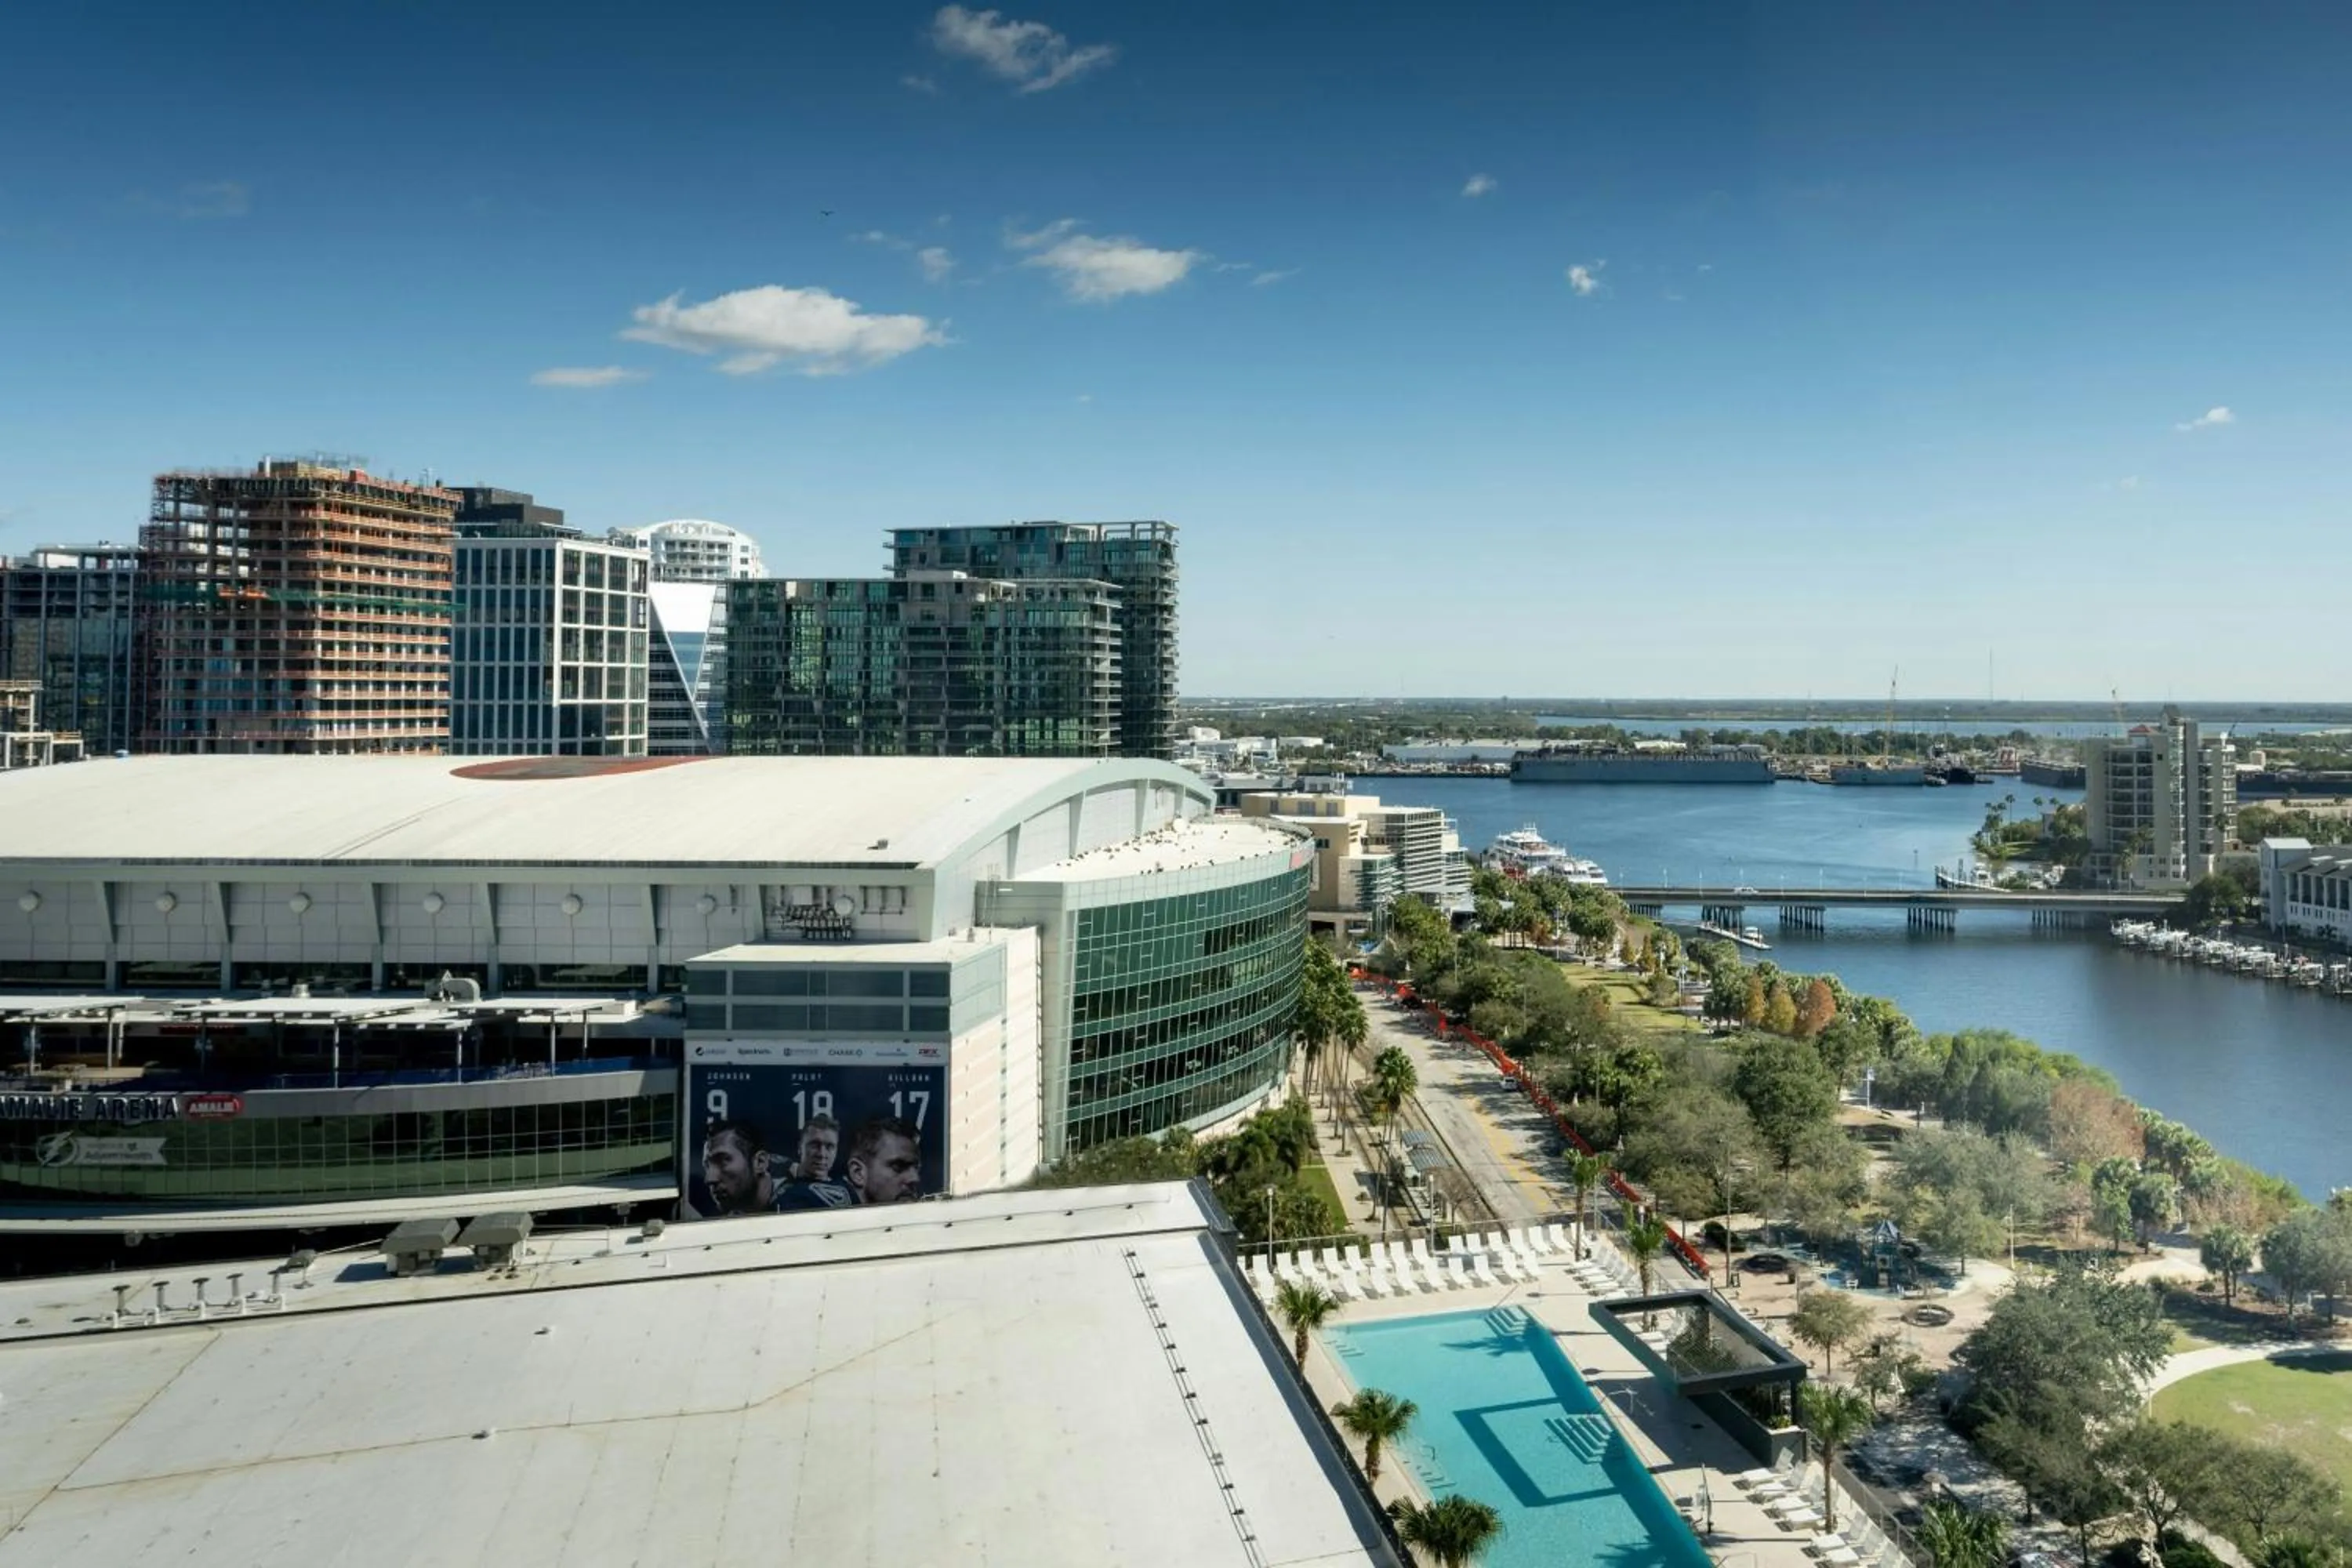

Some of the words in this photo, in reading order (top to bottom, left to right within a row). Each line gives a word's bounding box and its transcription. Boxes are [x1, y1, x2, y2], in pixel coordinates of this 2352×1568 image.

[94, 1095, 179, 1120] ARENA
[706, 1088, 728, 1124] 9
[791, 1090, 833, 1131] 18
[887, 1090, 931, 1131] 17
